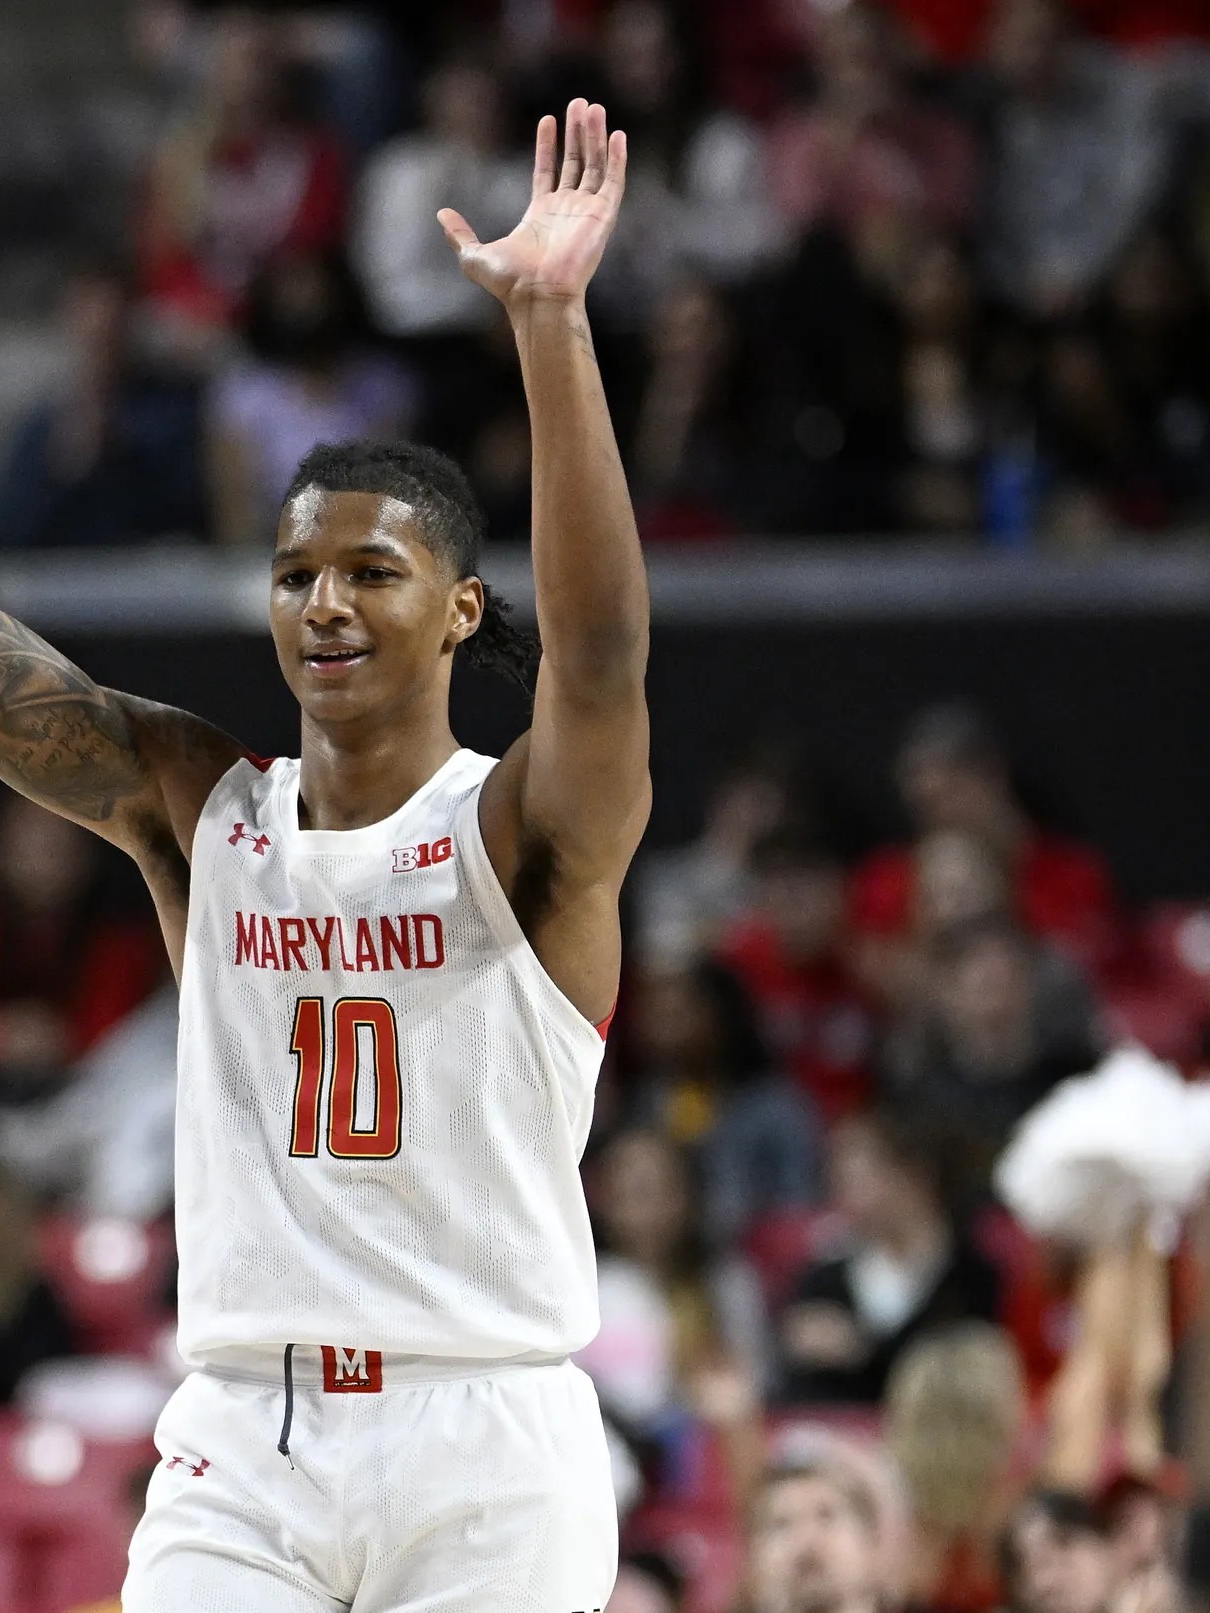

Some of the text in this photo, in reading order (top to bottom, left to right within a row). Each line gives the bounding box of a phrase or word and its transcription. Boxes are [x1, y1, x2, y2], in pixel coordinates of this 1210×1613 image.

[235, 911, 445, 972] MARYLAND
[288, 996, 403, 1160] 10
[334, 1346, 370, 1380] M
